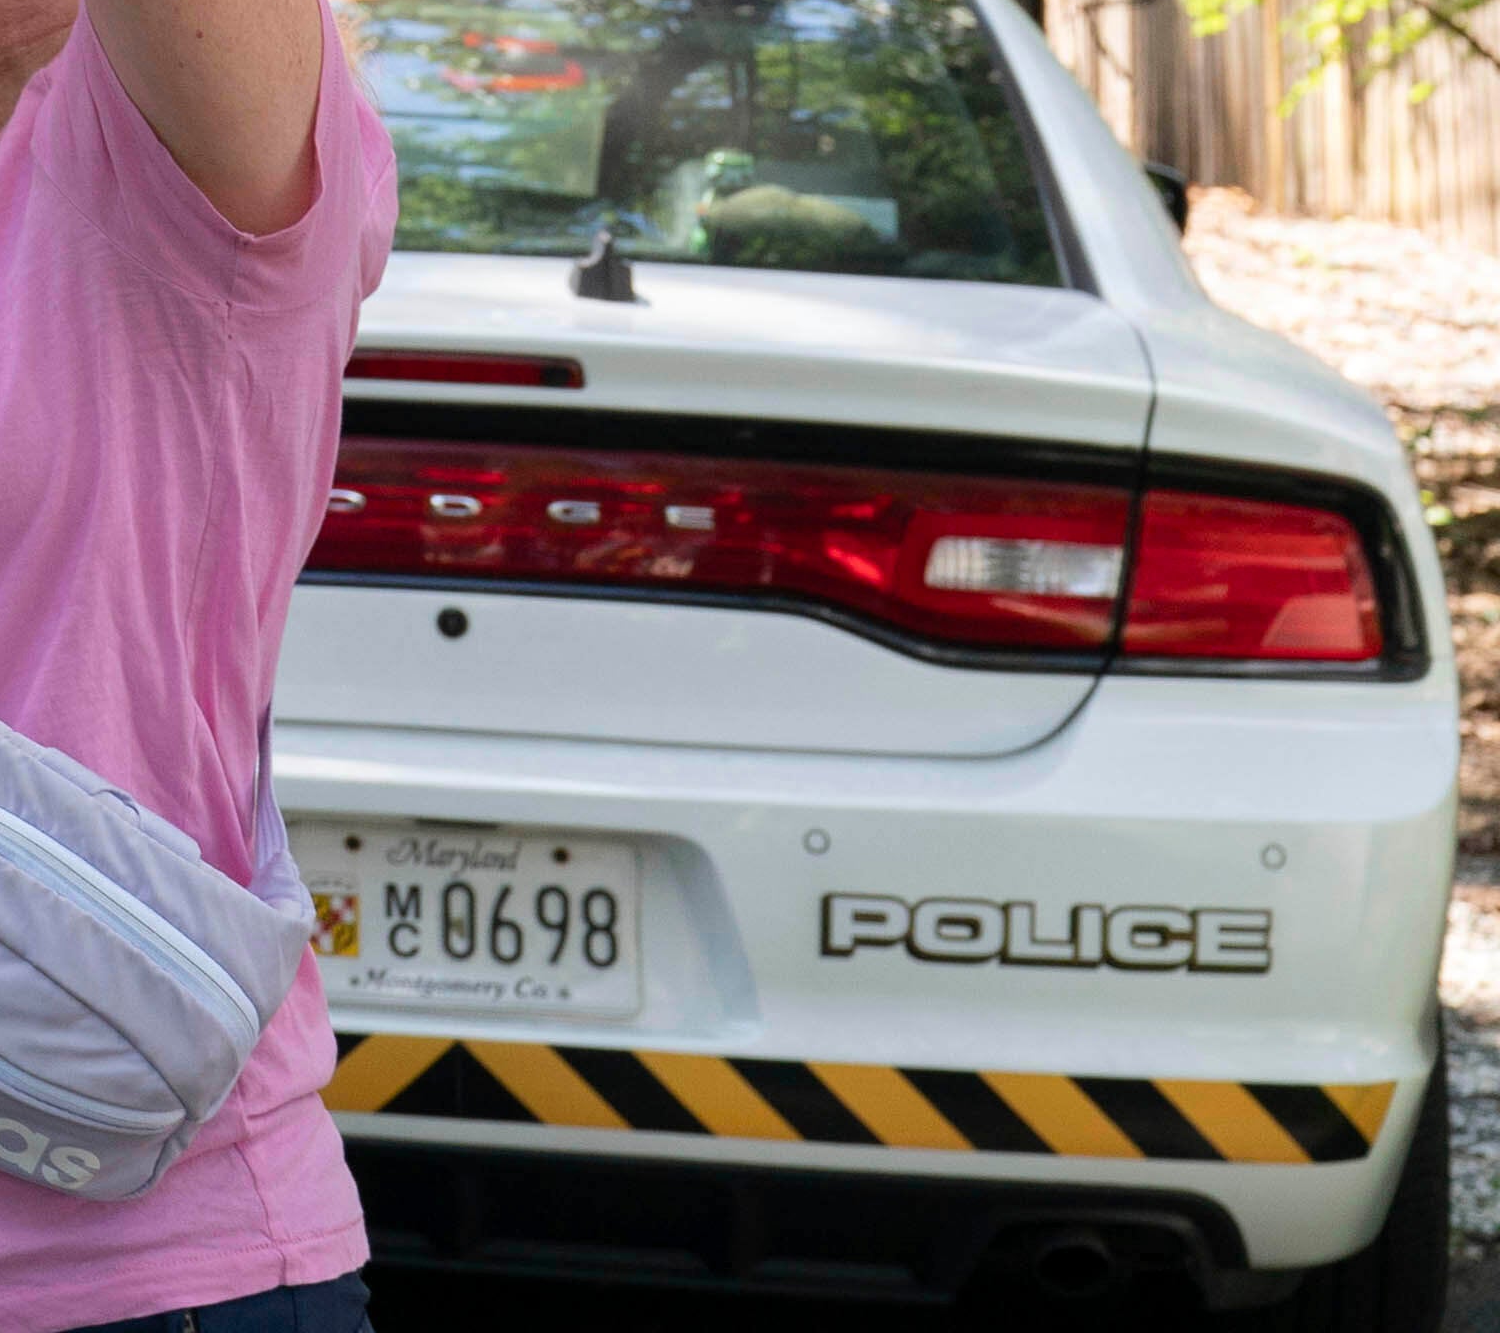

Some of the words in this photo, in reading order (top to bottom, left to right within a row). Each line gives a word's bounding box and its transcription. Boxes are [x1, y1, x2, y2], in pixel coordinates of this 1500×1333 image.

[328, 488, 716, 530] ODGE
[385, 836, 522, 877] Maryland
[819, 891, 1273, 974] POLICE
